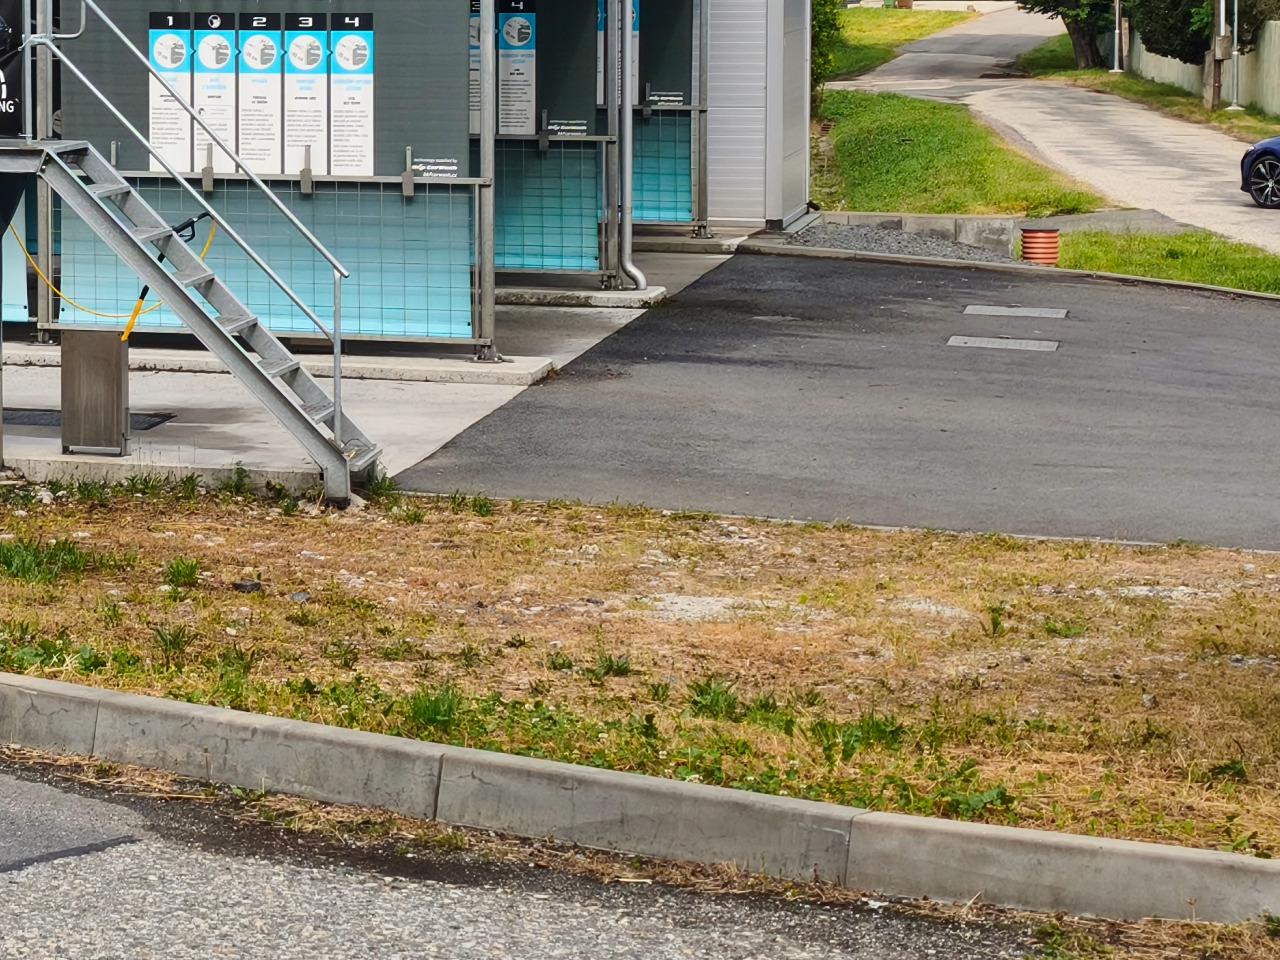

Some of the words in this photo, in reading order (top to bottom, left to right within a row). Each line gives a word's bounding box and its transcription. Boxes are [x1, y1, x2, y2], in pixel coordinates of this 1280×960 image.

[511, 1, 524, 10] 4
[166, 15, 174, 27] 1
[252, 16, 267, 27] 2
[298, 16, 313, 28] 3
[344, 16, 360, 28] 4
